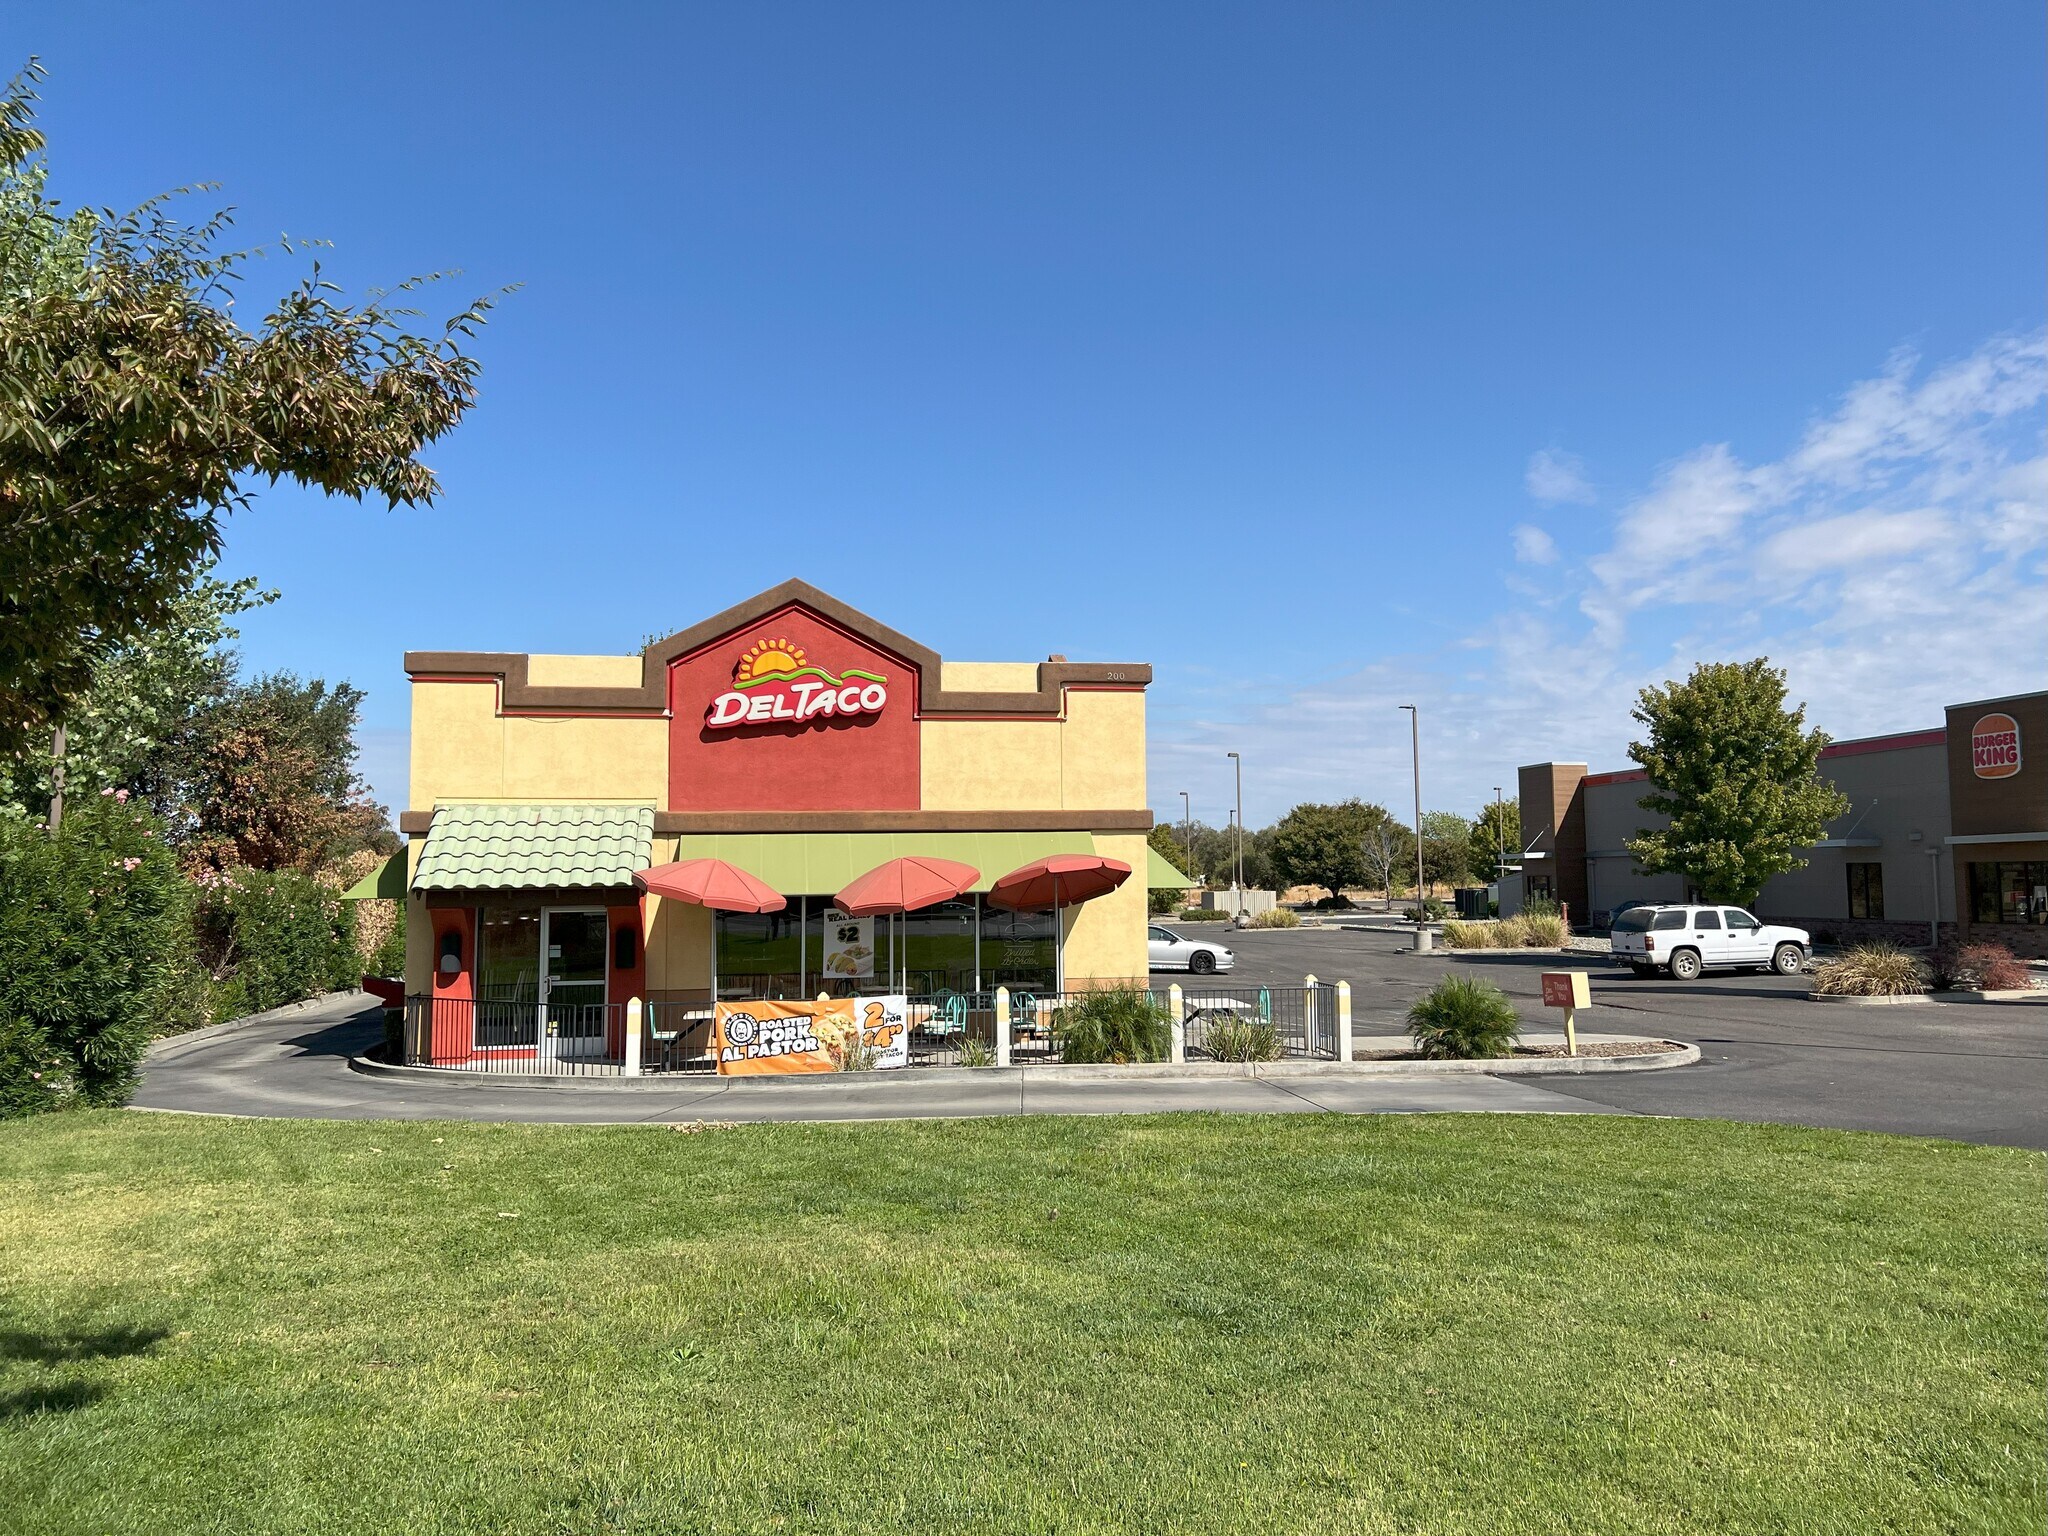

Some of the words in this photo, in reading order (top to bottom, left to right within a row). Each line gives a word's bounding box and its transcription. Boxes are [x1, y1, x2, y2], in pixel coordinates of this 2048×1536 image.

[1107, 672, 1125, 680] 200
[790, 682, 887, 719] TACO
[1973, 732, 2017, 749] BURGER
[1974, 745, 2018, 767] KING
[837, 926, 860, 943] $2
[1553, 982, 1569, 991] Thank
[1557, 992, 1567, 1000] You
[759, 1016, 812, 1030] ROASTED
[864, 1001, 884, 1029] 2
[885, 1015, 902, 1024] FOR
[759, 1025, 812, 1044] PORK
[720, 1046, 745, 1063] AL
[747, 1037, 819, 1059] PASTOR
